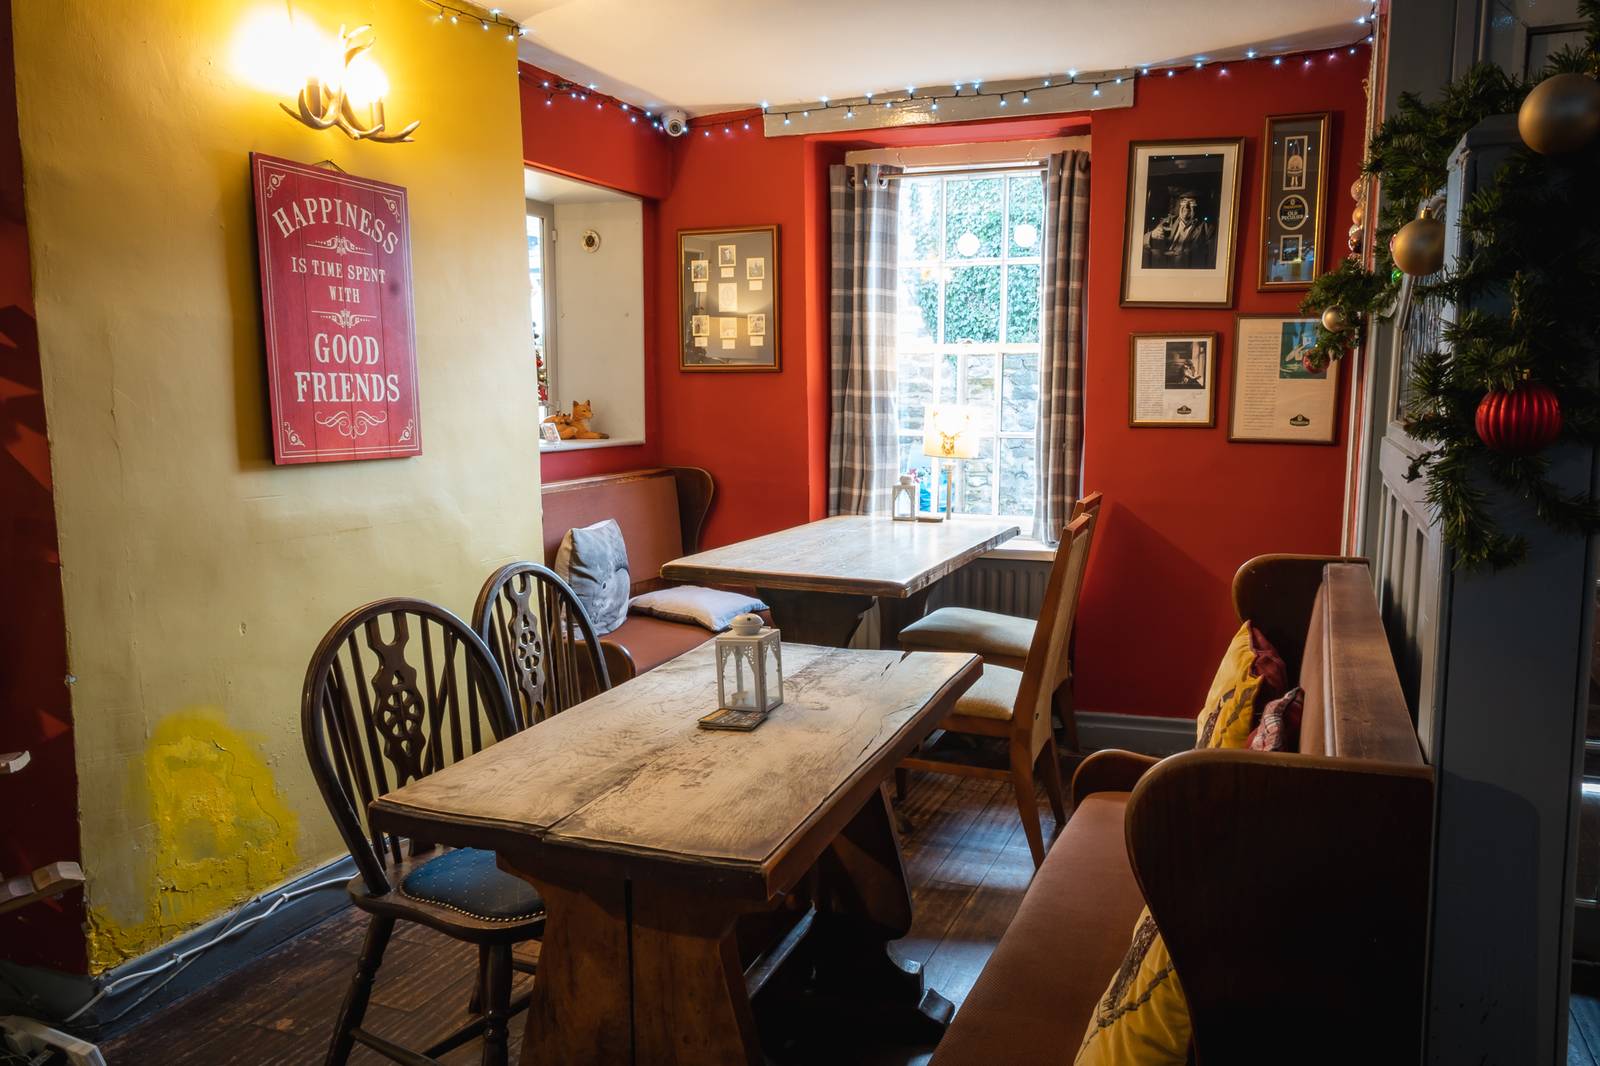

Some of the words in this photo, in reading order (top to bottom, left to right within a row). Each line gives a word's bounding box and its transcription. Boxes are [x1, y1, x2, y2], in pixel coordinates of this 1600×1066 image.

[272, 197, 399, 254] HAPPINESS
[291, 256, 307, 273] IS
[312, 260, 343, 279] TIME
[347, 264, 386, 283] SPENT
[329, 286, 360, 303] WITH
[314, 333, 379, 365] GOOD
[294, 372, 401, 402] FRIENDS
